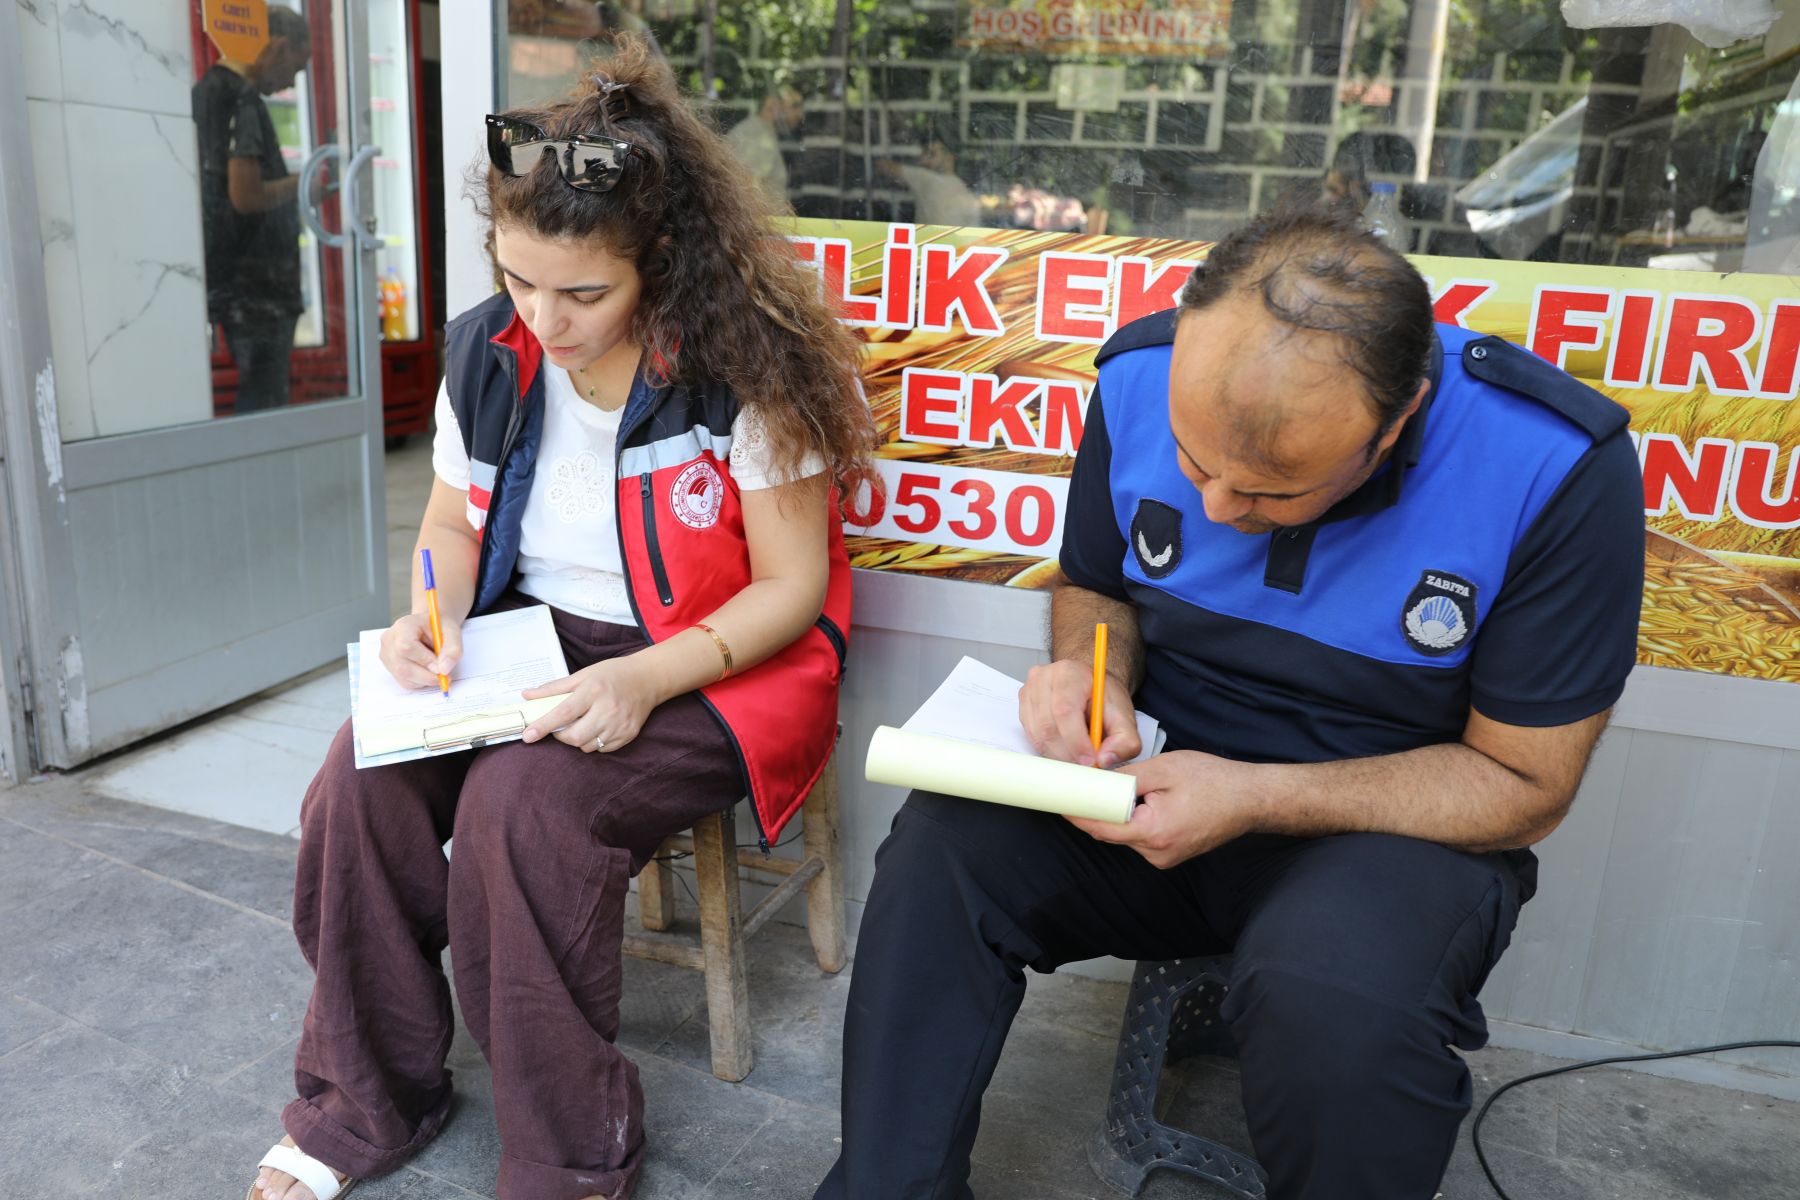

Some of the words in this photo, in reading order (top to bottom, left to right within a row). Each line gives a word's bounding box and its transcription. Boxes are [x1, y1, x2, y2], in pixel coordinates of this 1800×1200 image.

[972, 8, 1040, 43] HOŞ
[1051, 7, 1212, 41] GLDİNİZ
[788, 225, 1006, 335] LİK
[840, 467, 1056, 547] 0530
[1637, 435, 1800, 526] NU
[1425, 575, 1470, 597] ZABITA
